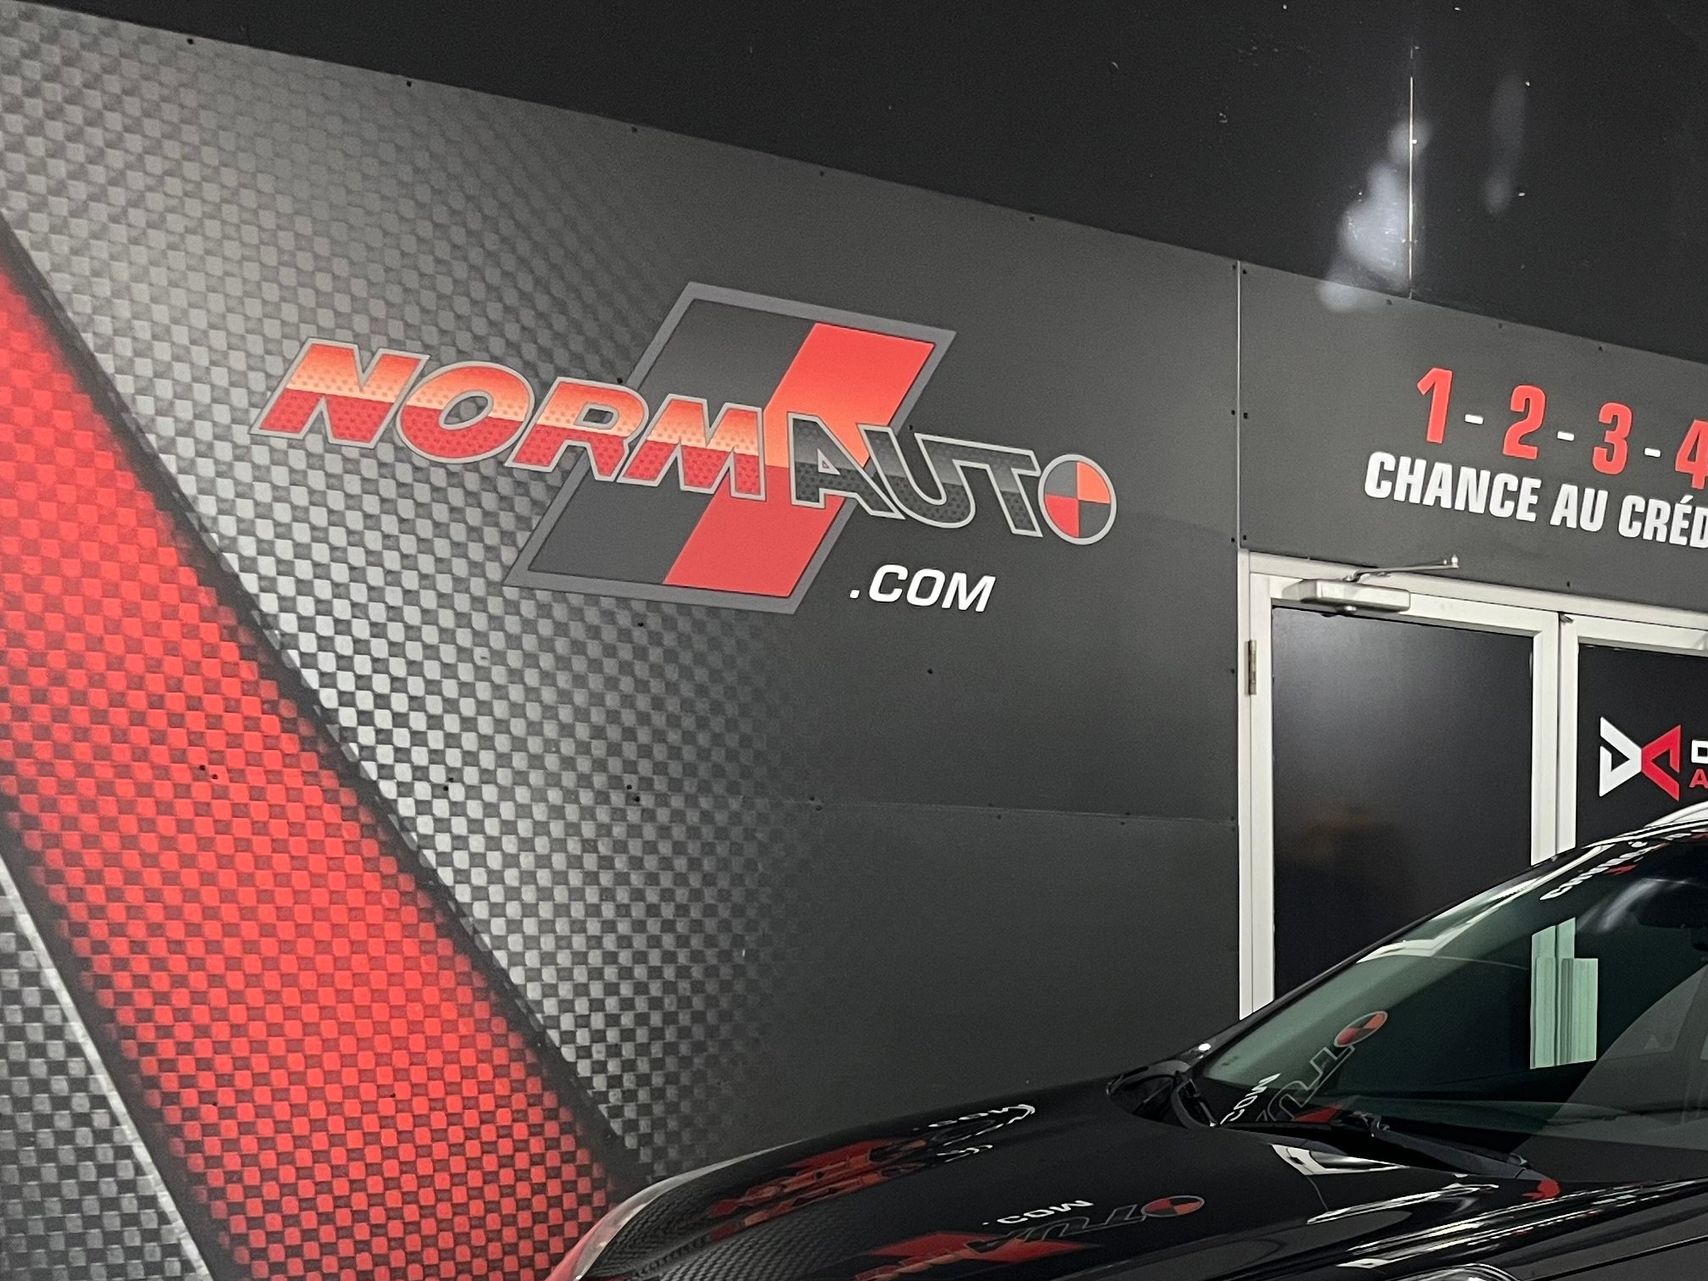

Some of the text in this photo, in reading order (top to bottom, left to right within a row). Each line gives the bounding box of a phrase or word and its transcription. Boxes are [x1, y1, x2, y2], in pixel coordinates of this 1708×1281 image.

[1364, 450, 1542, 523] CHANCE
[1550, 483, 1609, 532] AU
[849, 563, 996, 613] .COM
